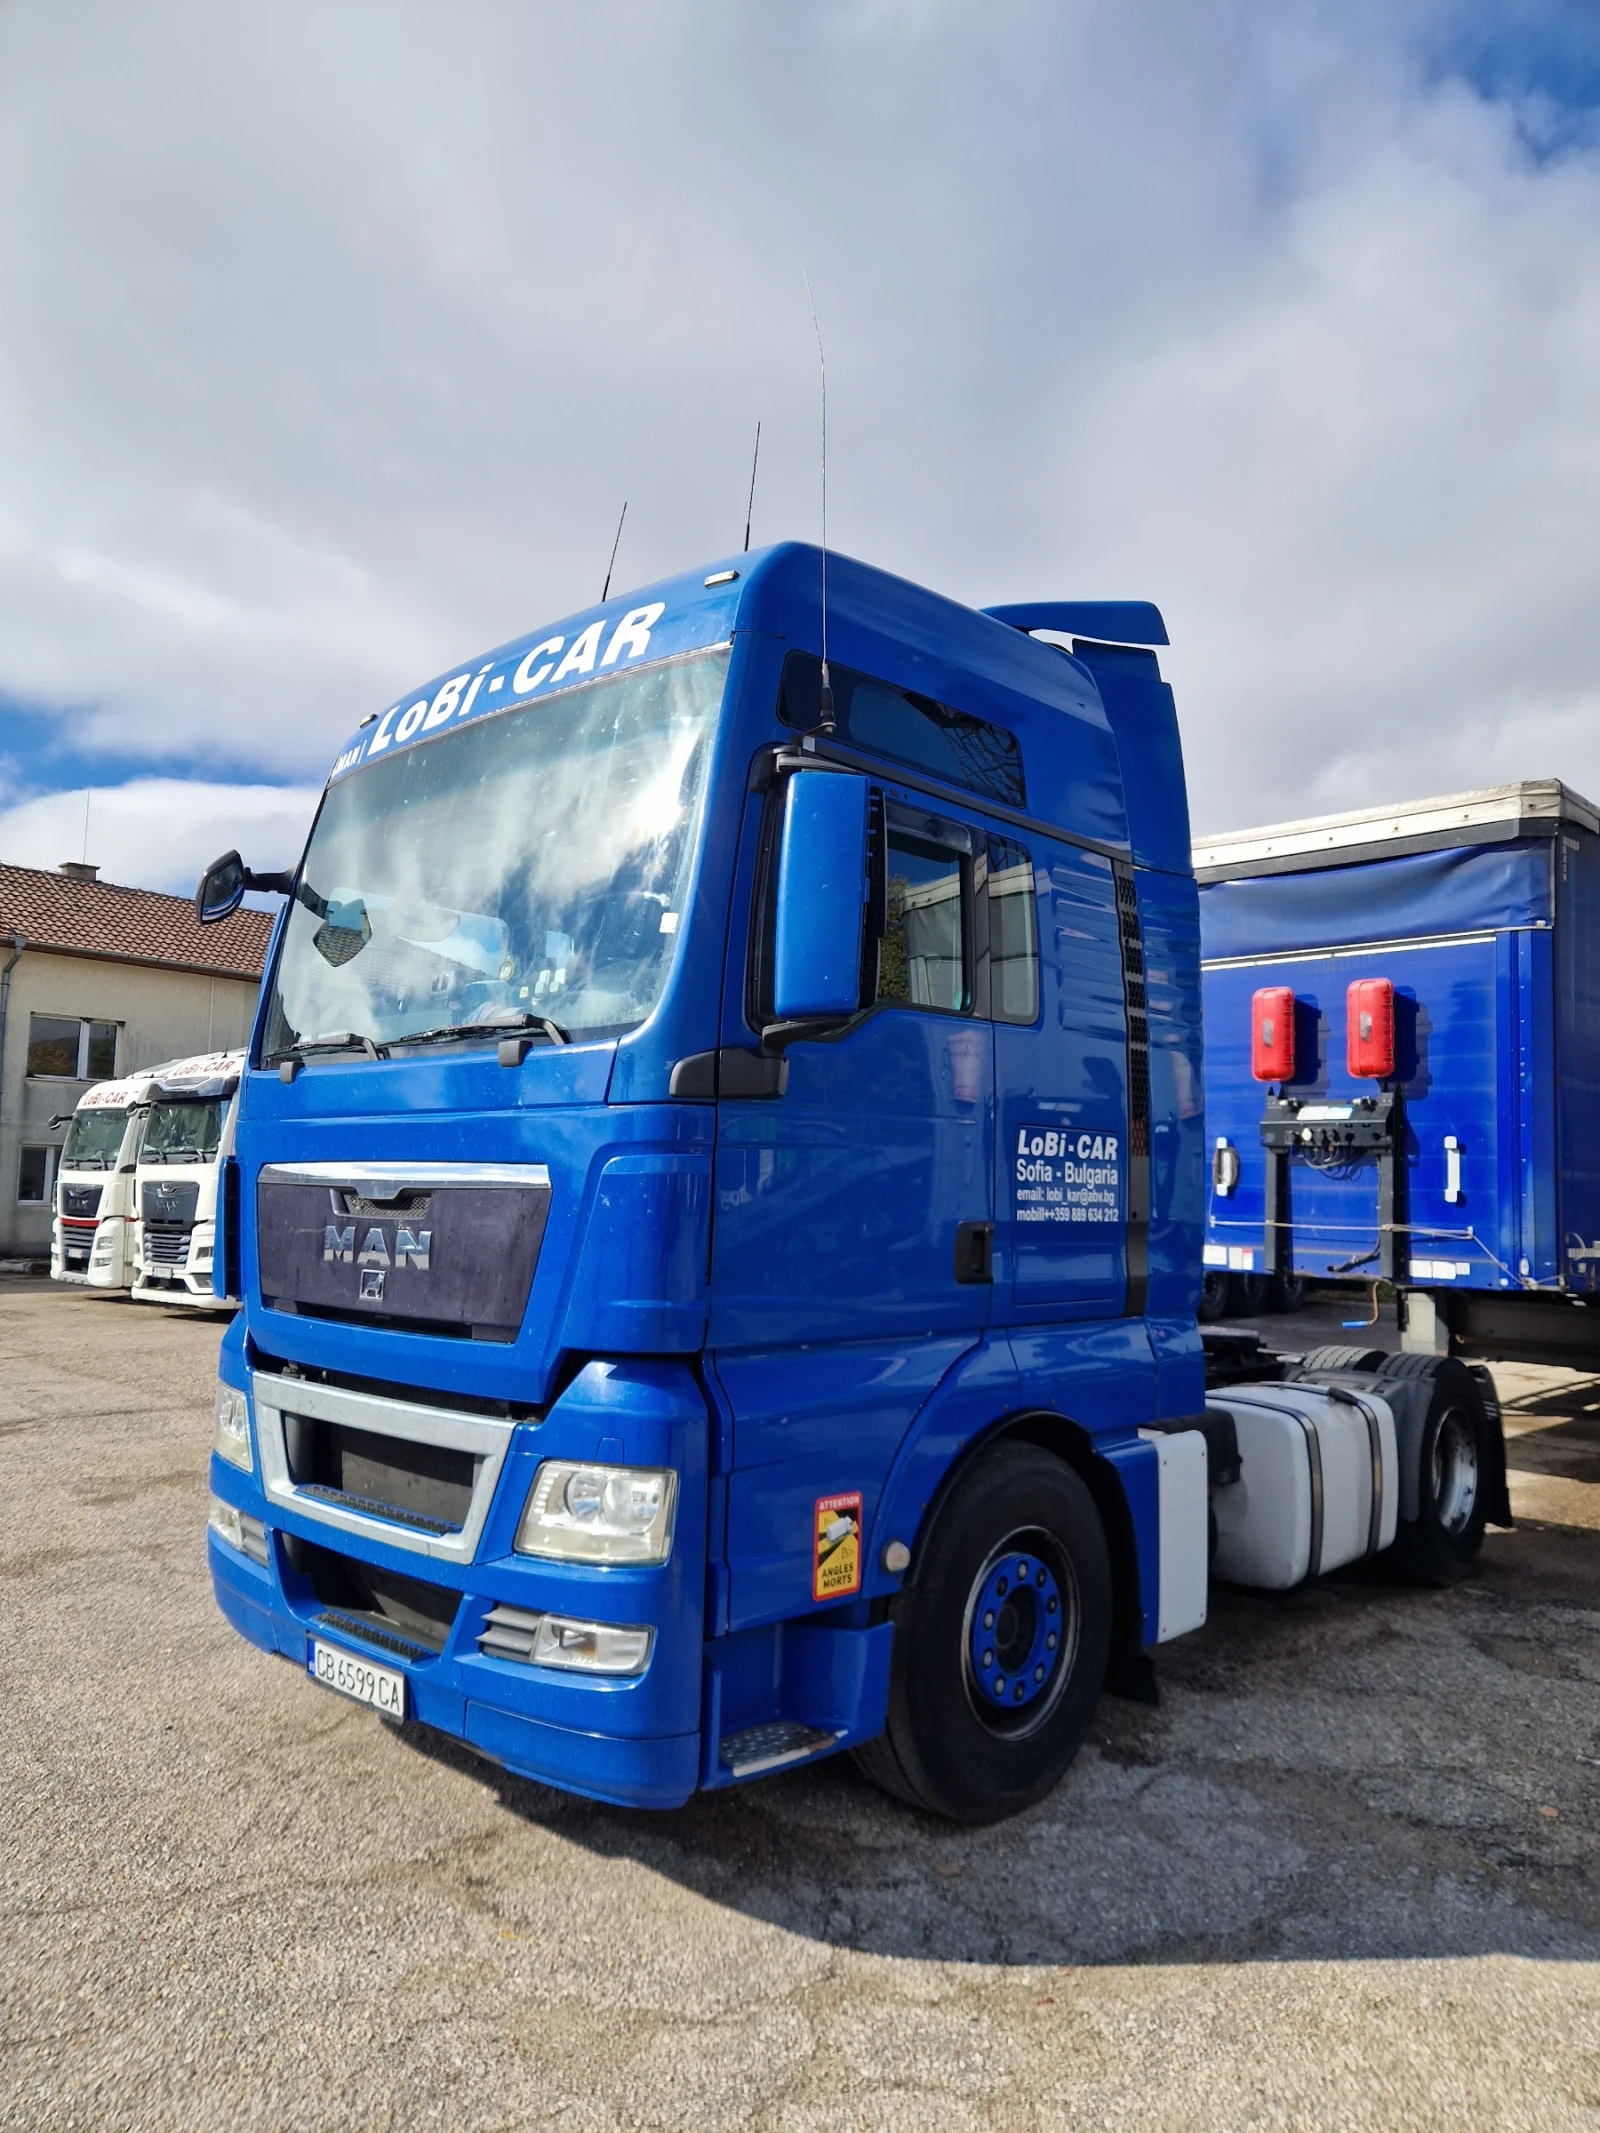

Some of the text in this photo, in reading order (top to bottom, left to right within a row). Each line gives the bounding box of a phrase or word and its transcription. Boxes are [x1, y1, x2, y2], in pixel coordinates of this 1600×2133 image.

[1016, 1159, 1052, 1182] Sofia
[1065, 1162, 1118, 1189] Bulgaria
[1104, 1208, 1119, 1223] 212
[324, 1225, 432, 1270] MAN
[819, 1495, 860, 1511] ATTENTION
[822, 1562, 854, 1578] ANGLES
[823, 1574, 852, 1588] MORTS
